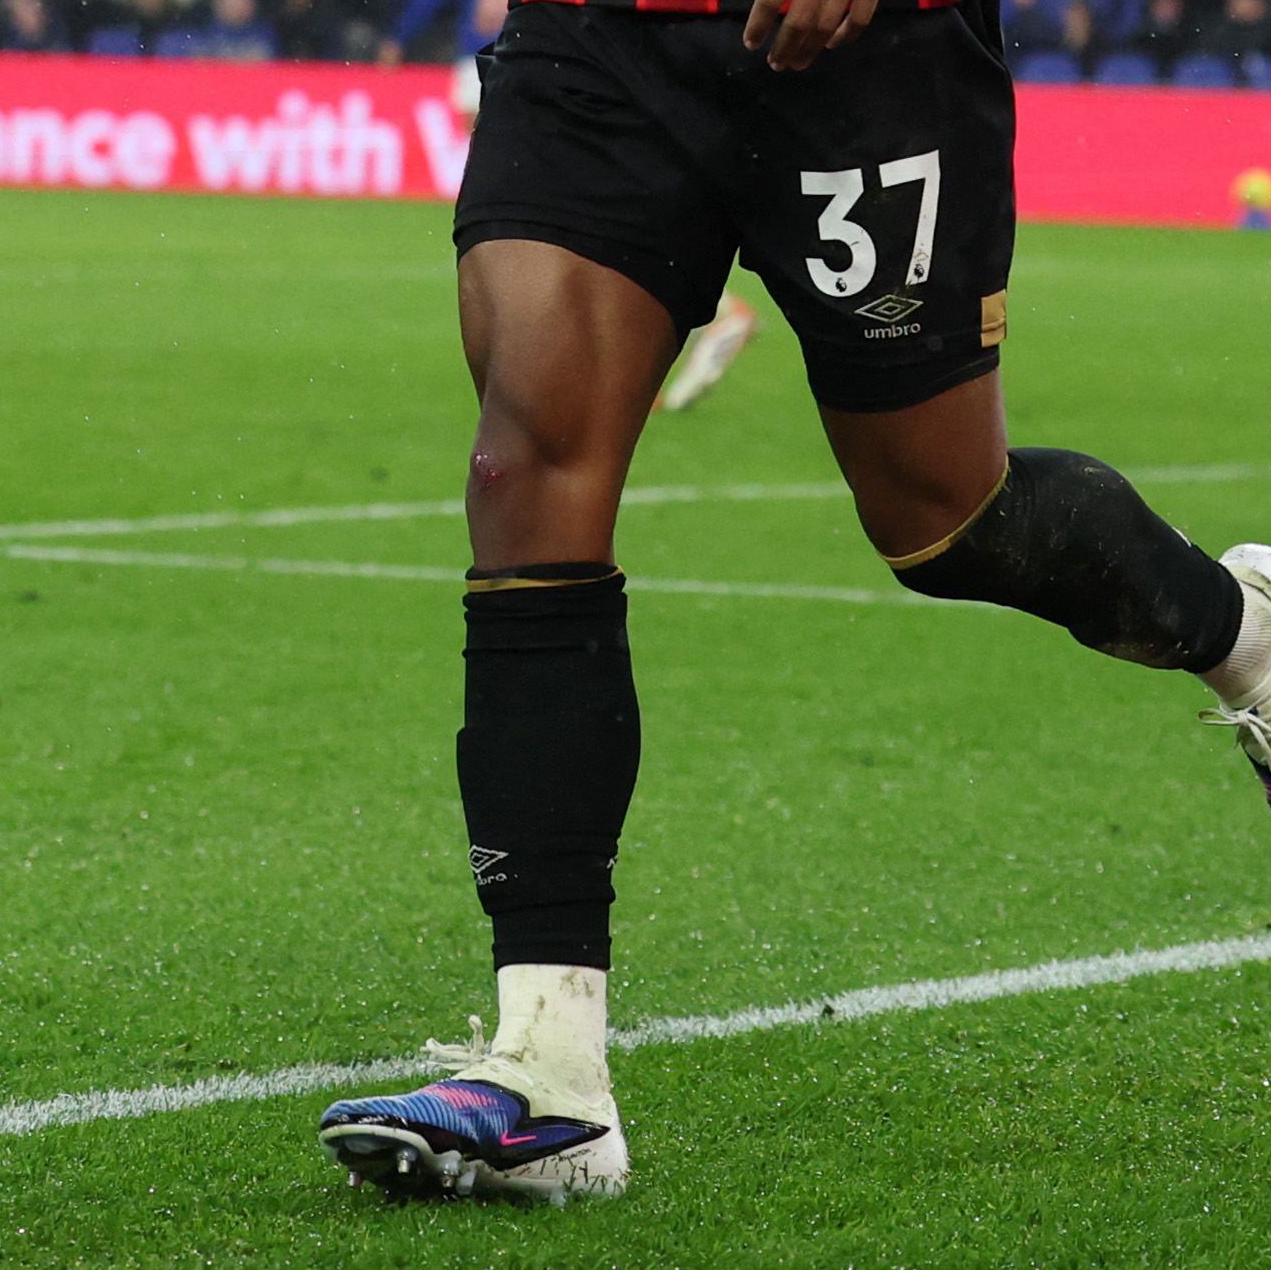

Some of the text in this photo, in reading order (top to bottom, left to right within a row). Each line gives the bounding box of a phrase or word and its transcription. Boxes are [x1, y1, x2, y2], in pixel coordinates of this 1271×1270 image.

[189, 88, 403, 196] with
[800, 149, 941, 298] 37
[864, 322, 921, 340] umbro
